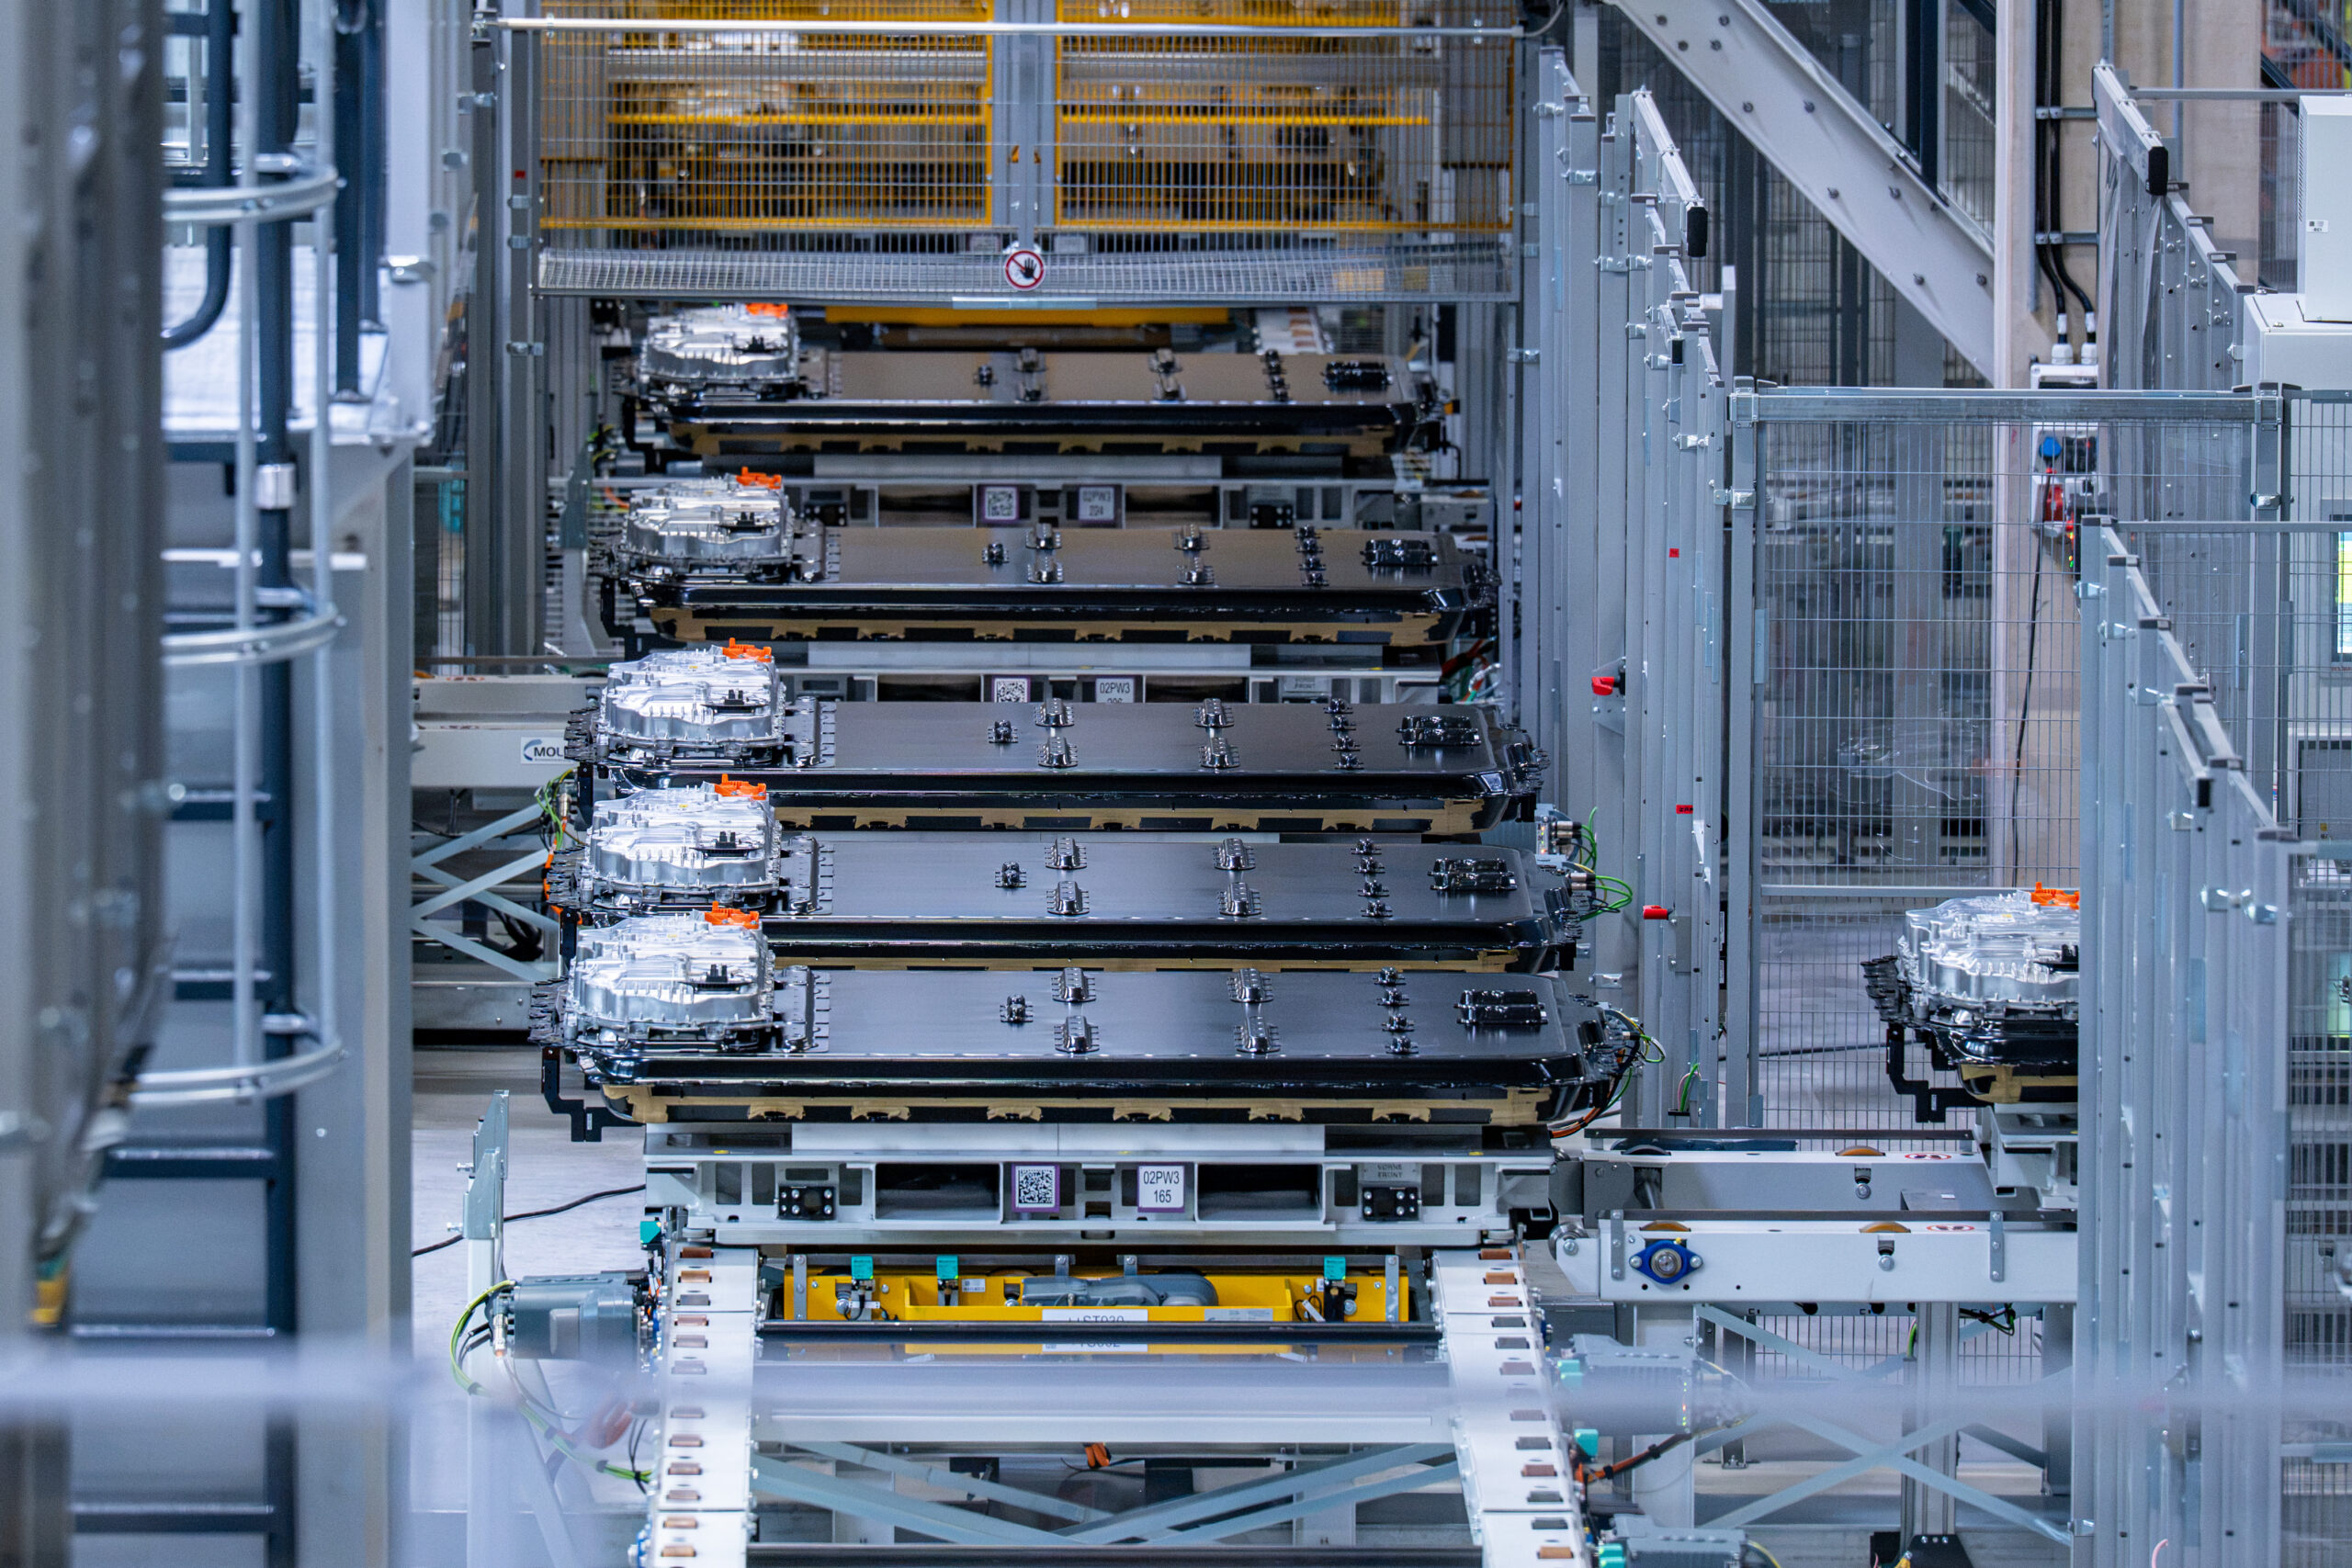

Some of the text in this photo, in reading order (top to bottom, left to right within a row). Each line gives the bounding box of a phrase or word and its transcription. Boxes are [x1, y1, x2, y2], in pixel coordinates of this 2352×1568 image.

[1100, 682, 1130, 694] 02PW3
[1143, 1170, 1180, 1185] 02PW3
[1154, 1189, 1171, 1203] 165
